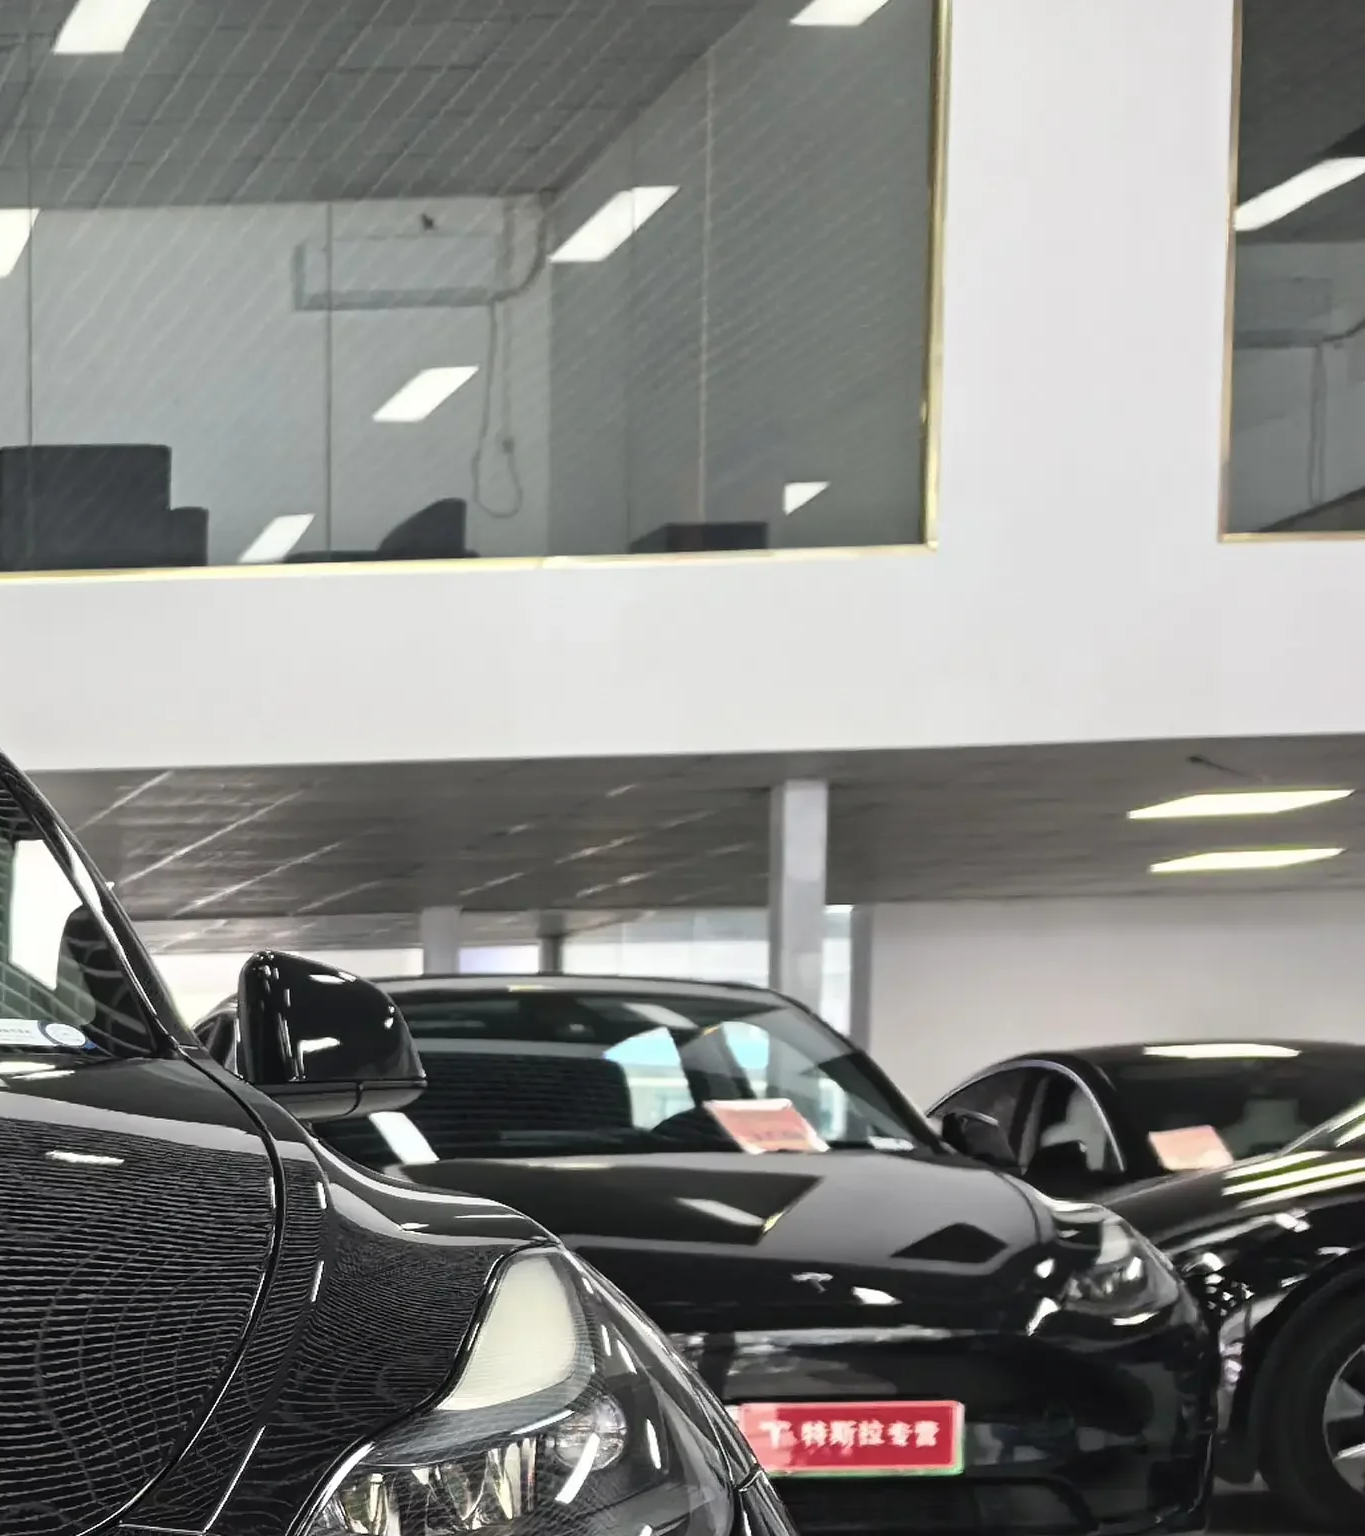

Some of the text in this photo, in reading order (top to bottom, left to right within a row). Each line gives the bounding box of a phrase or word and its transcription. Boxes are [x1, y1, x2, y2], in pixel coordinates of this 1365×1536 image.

[801, 1419, 940, 1447] 特斯拉专营
